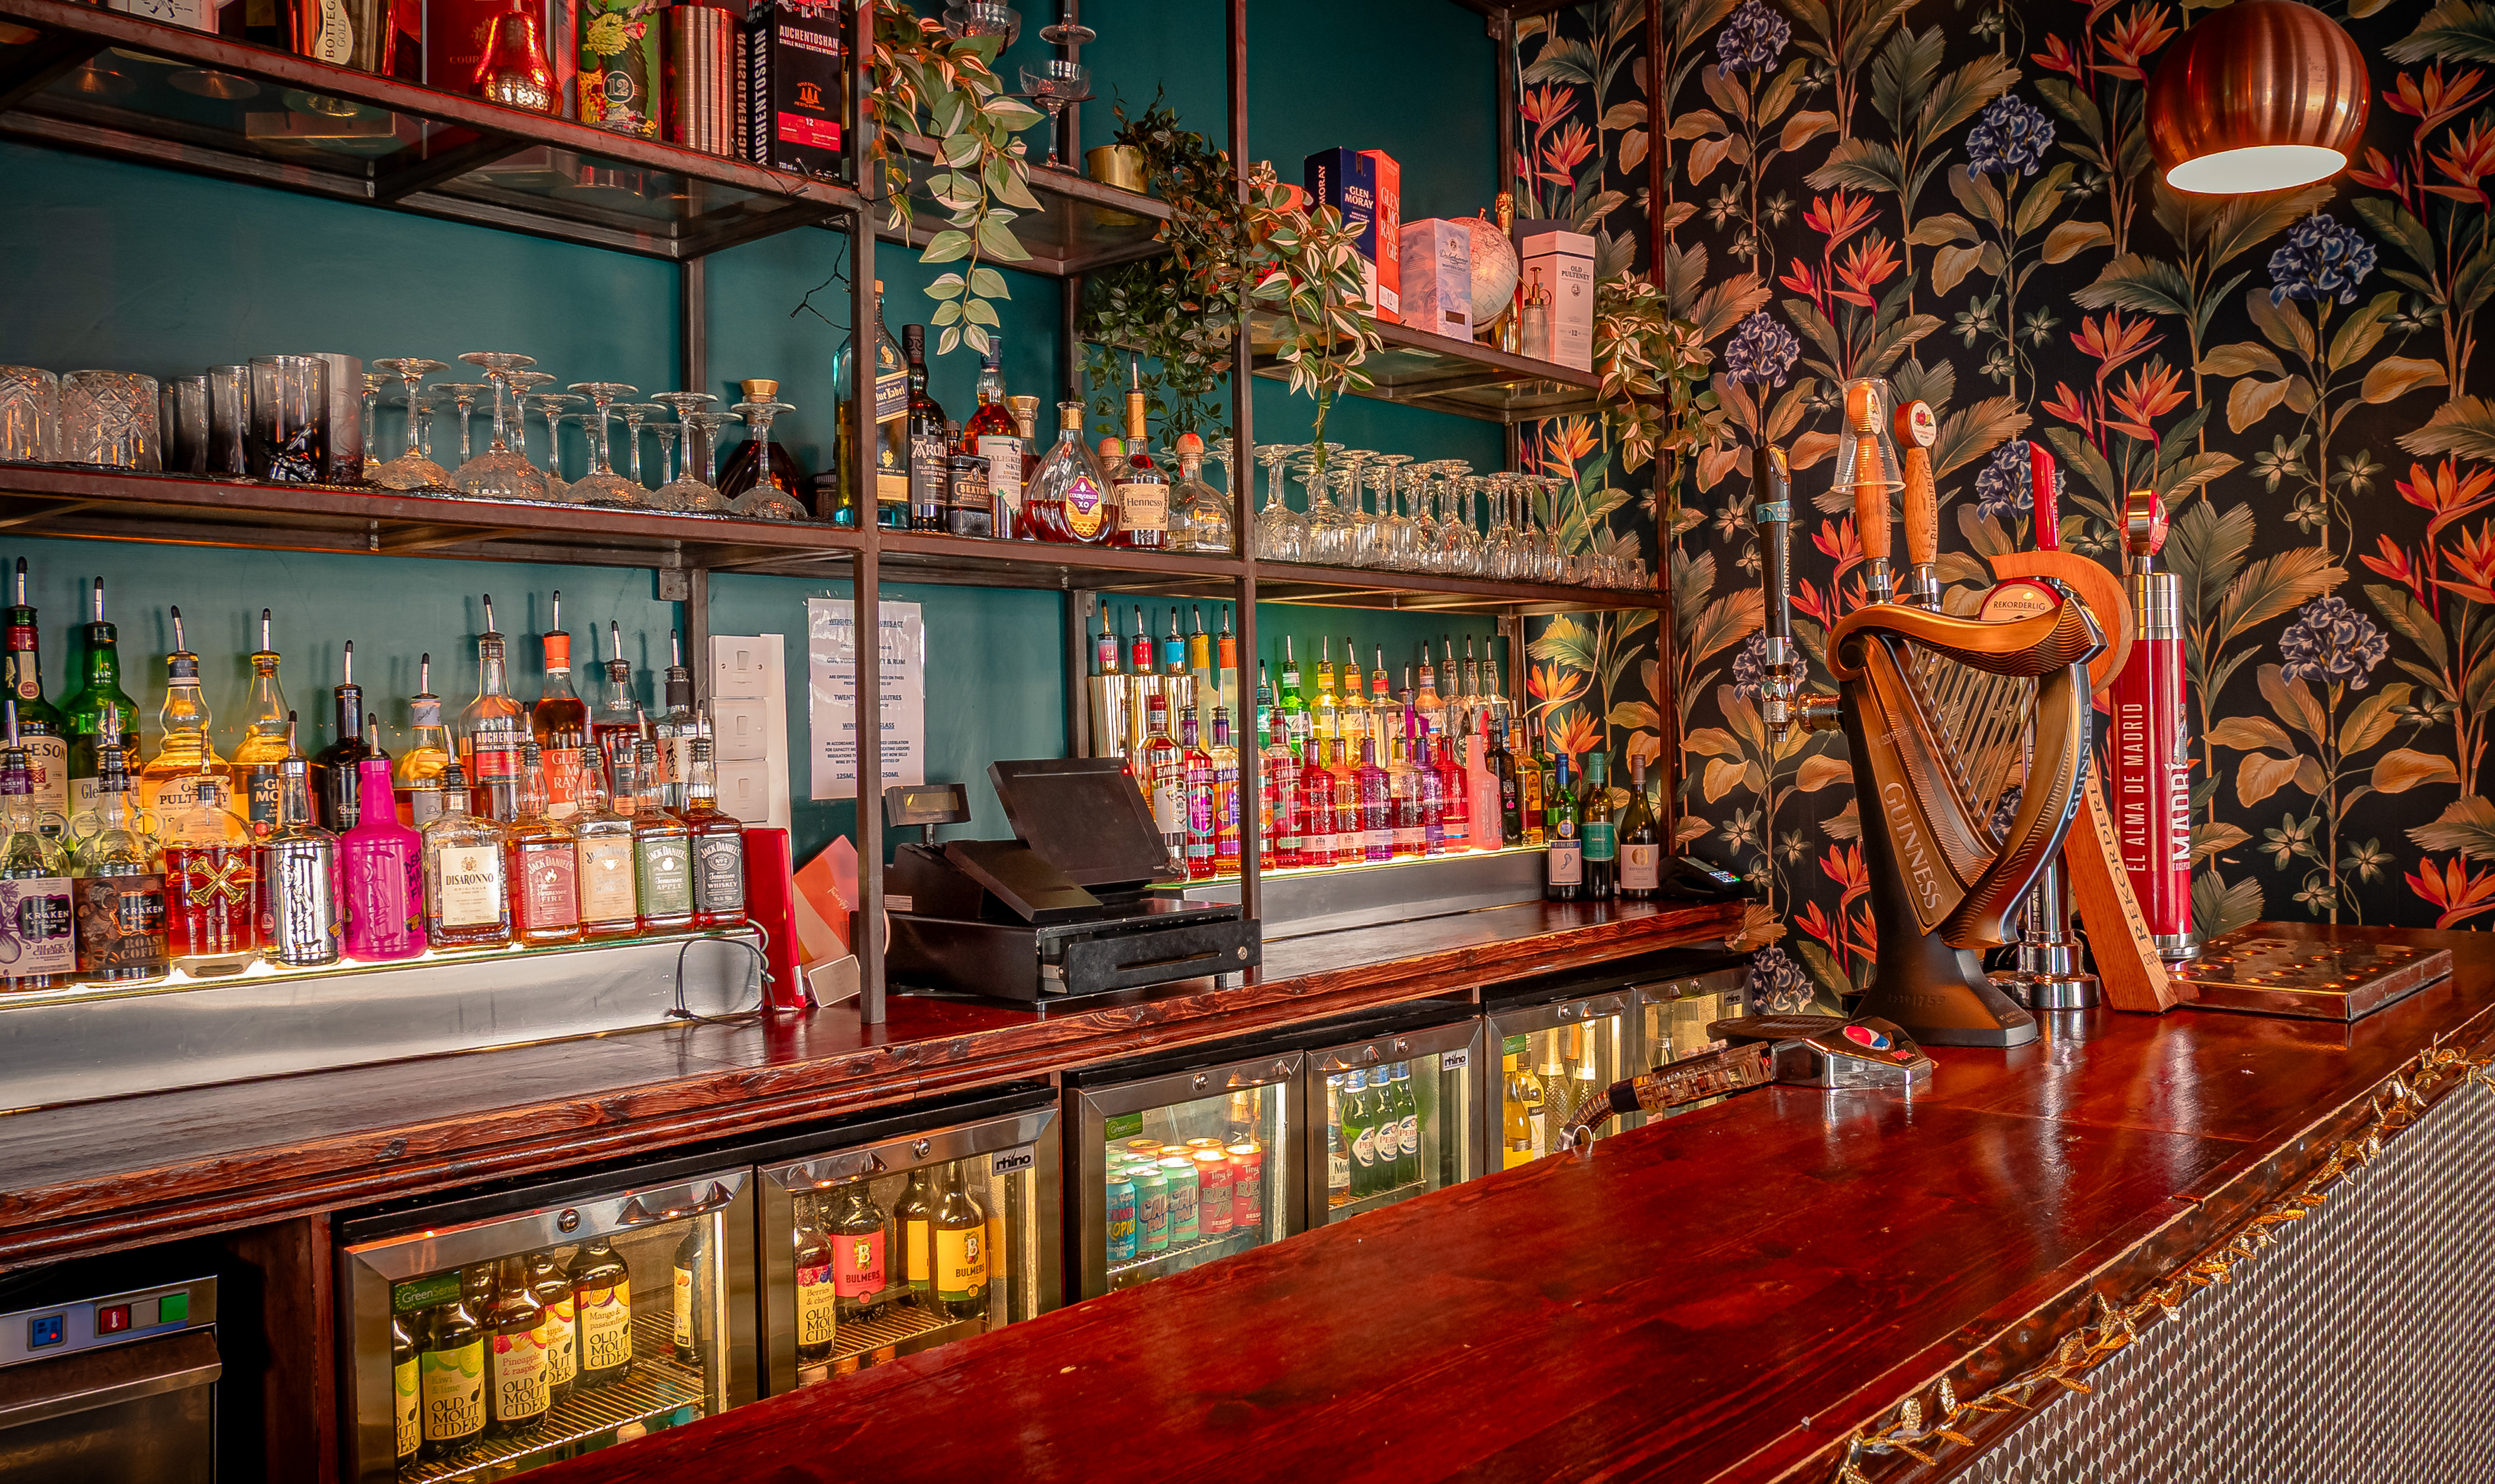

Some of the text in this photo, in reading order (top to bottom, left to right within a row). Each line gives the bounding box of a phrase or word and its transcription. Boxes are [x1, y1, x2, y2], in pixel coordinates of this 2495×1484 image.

[325, 0, 336, 58] BOTTEG
[337, 19, 346, 48] GOLD
[779, 25, 839, 50] AUCHENTOSHAN
[607, 78, 629, 96] 12
[755, 28, 767, 166] AUCHENTOSHAN
[805, 118, 814, 127] 12
[1349, 186, 1369, 199] GLEN
[1381, 187, 1399, 212] GLEN
[1344, 193, 1374, 209] MORAY
[1380, 220, 1396, 244] RAN
[1386, 241, 1399, 262] GIE
[1561, 270, 1590, 281] PULTENEY
[875, 385, 905, 401] lue Label
[911, 438, 946, 459] Ardb
[1127, 498, 1163, 507] Hennessy
[1923, 461, 1937, 540] REKORDERLIG
[1993, 601, 2046, 610] REKORDERLIG
[476, 731, 525, 744] AUCHENTOSH
[2067, 703, 2092, 820] GUINNESS
[1503, 785, 1515, 794] ROSE
[2122, 704, 2146, 871] EL ALMA DE MADRID
[700, 841, 742, 859] JACK DANIEL'S
[1884, 782, 1943, 909] GUINNESS
[646, 845, 690, 863] JACK DANIEL'S
[527, 856, 575, 875] JACK DANIEL'S
[446, 873, 494, 886] DISARONNO
[655, 877, 683, 885] Tennessee
[656, 883, 683, 891] APPLE
[25, 910, 69, 920] KRAKEN
[122, 905, 164, 915] KRAKEN
[124, 935, 164, 949] ROAST
[2143, 951, 2160, 966] CIDER
[1726, 992, 1740, 1003] rhino
[1912, 995, 1947, 1007] 1759
[1445, 1051, 1466, 1067] rhino
[1111, 1120, 1142, 1134] GreenSense
[996, 1149, 1031, 1171] rhino
[1208, 1170, 1227, 1184] Tiny
[1242, 1164, 1260, 1178] Tiny
[1174, 1204, 1196, 1223] PALE
[1147, 1214, 1167, 1233] PALE
[845, 1270, 881, 1283] BULMERS
[956, 1263, 985, 1278] BULMERS
[402, 1282, 461, 1304] GreenSense
[807, 1287, 830, 1297] Berries
[590, 1310, 615, 1321] Mango
[805, 1306, 830, 1320] OLD
[590, 1330, 618, 1345] OLD
[591, 1334, 629, 1356] MOUT
[502, 1352, 541, 1367] Pineapple
[590, 1347, 629, 1368] CIDER
[431, 1373, 452, 1385] Kiwi
[503, 1368, 510, 1376] &
[432, 1384, 461, 1394] & lime
[503, 1378, 534, 1394] OLD
[504, 1383, 547, 1405] MOUT
[431, 1396, 465, 1413] OLD
[503, 1395, 547, 1417] CIDER
[432, 1401, 480, 1425] MOUT
[432, 1415, 480, 1438] CIDER
